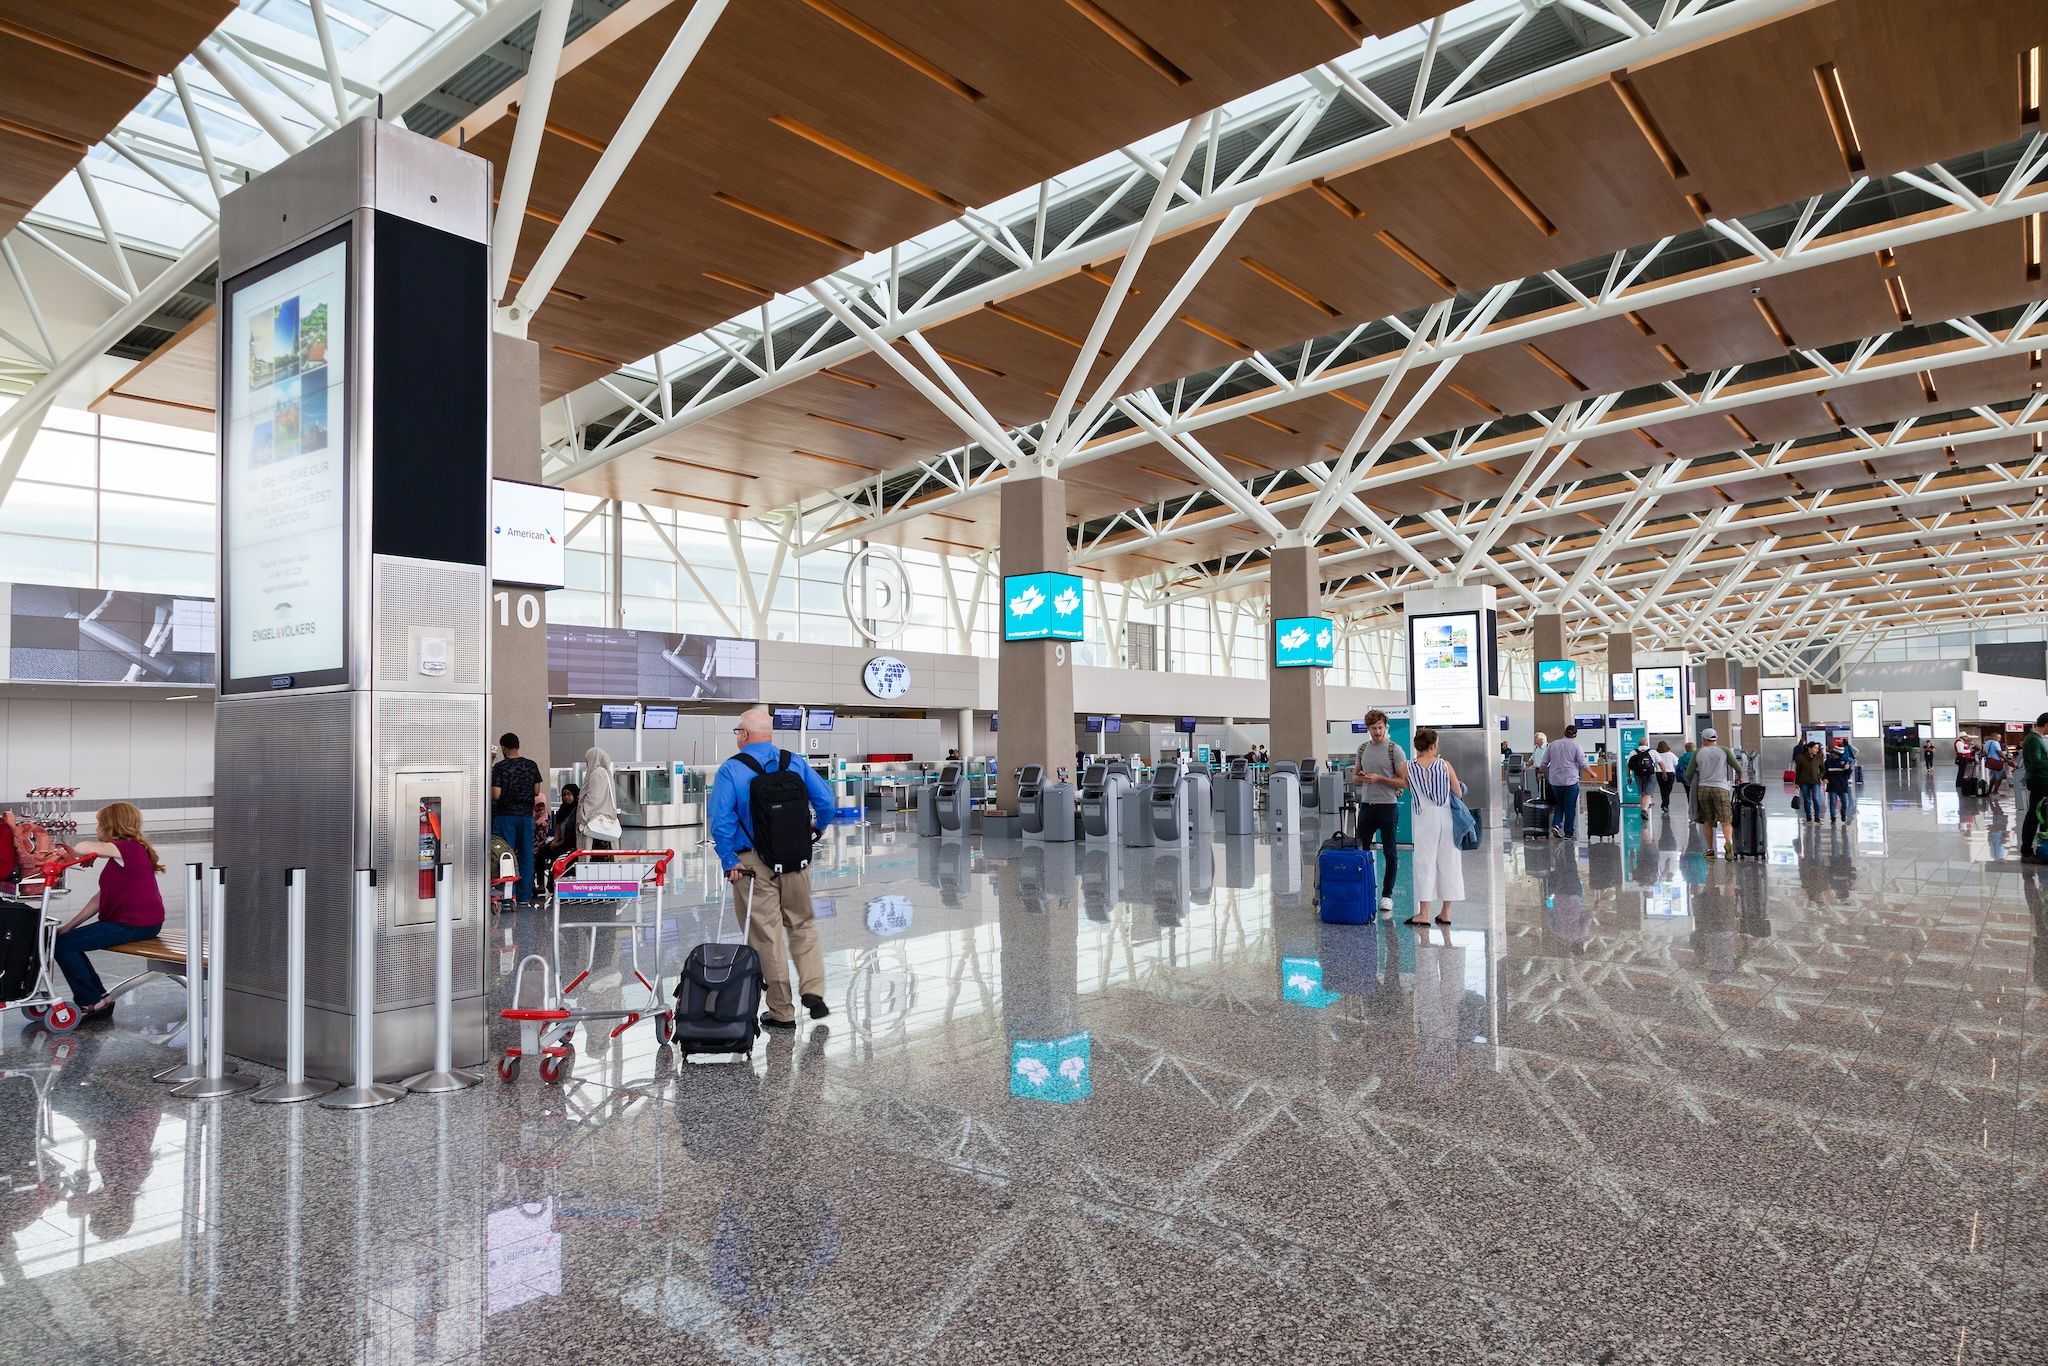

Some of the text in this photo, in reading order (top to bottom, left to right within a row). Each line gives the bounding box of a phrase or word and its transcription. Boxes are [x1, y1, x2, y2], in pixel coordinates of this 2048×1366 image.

[507, 527, 545, 541] American
[864, 566, 901, 620] D
[493, 591, 540, 628] 10
[1055, 643, 1066, 667] 9
[1315, 669, 1322, 687] 8
[812, 739, 817, 748] 6
